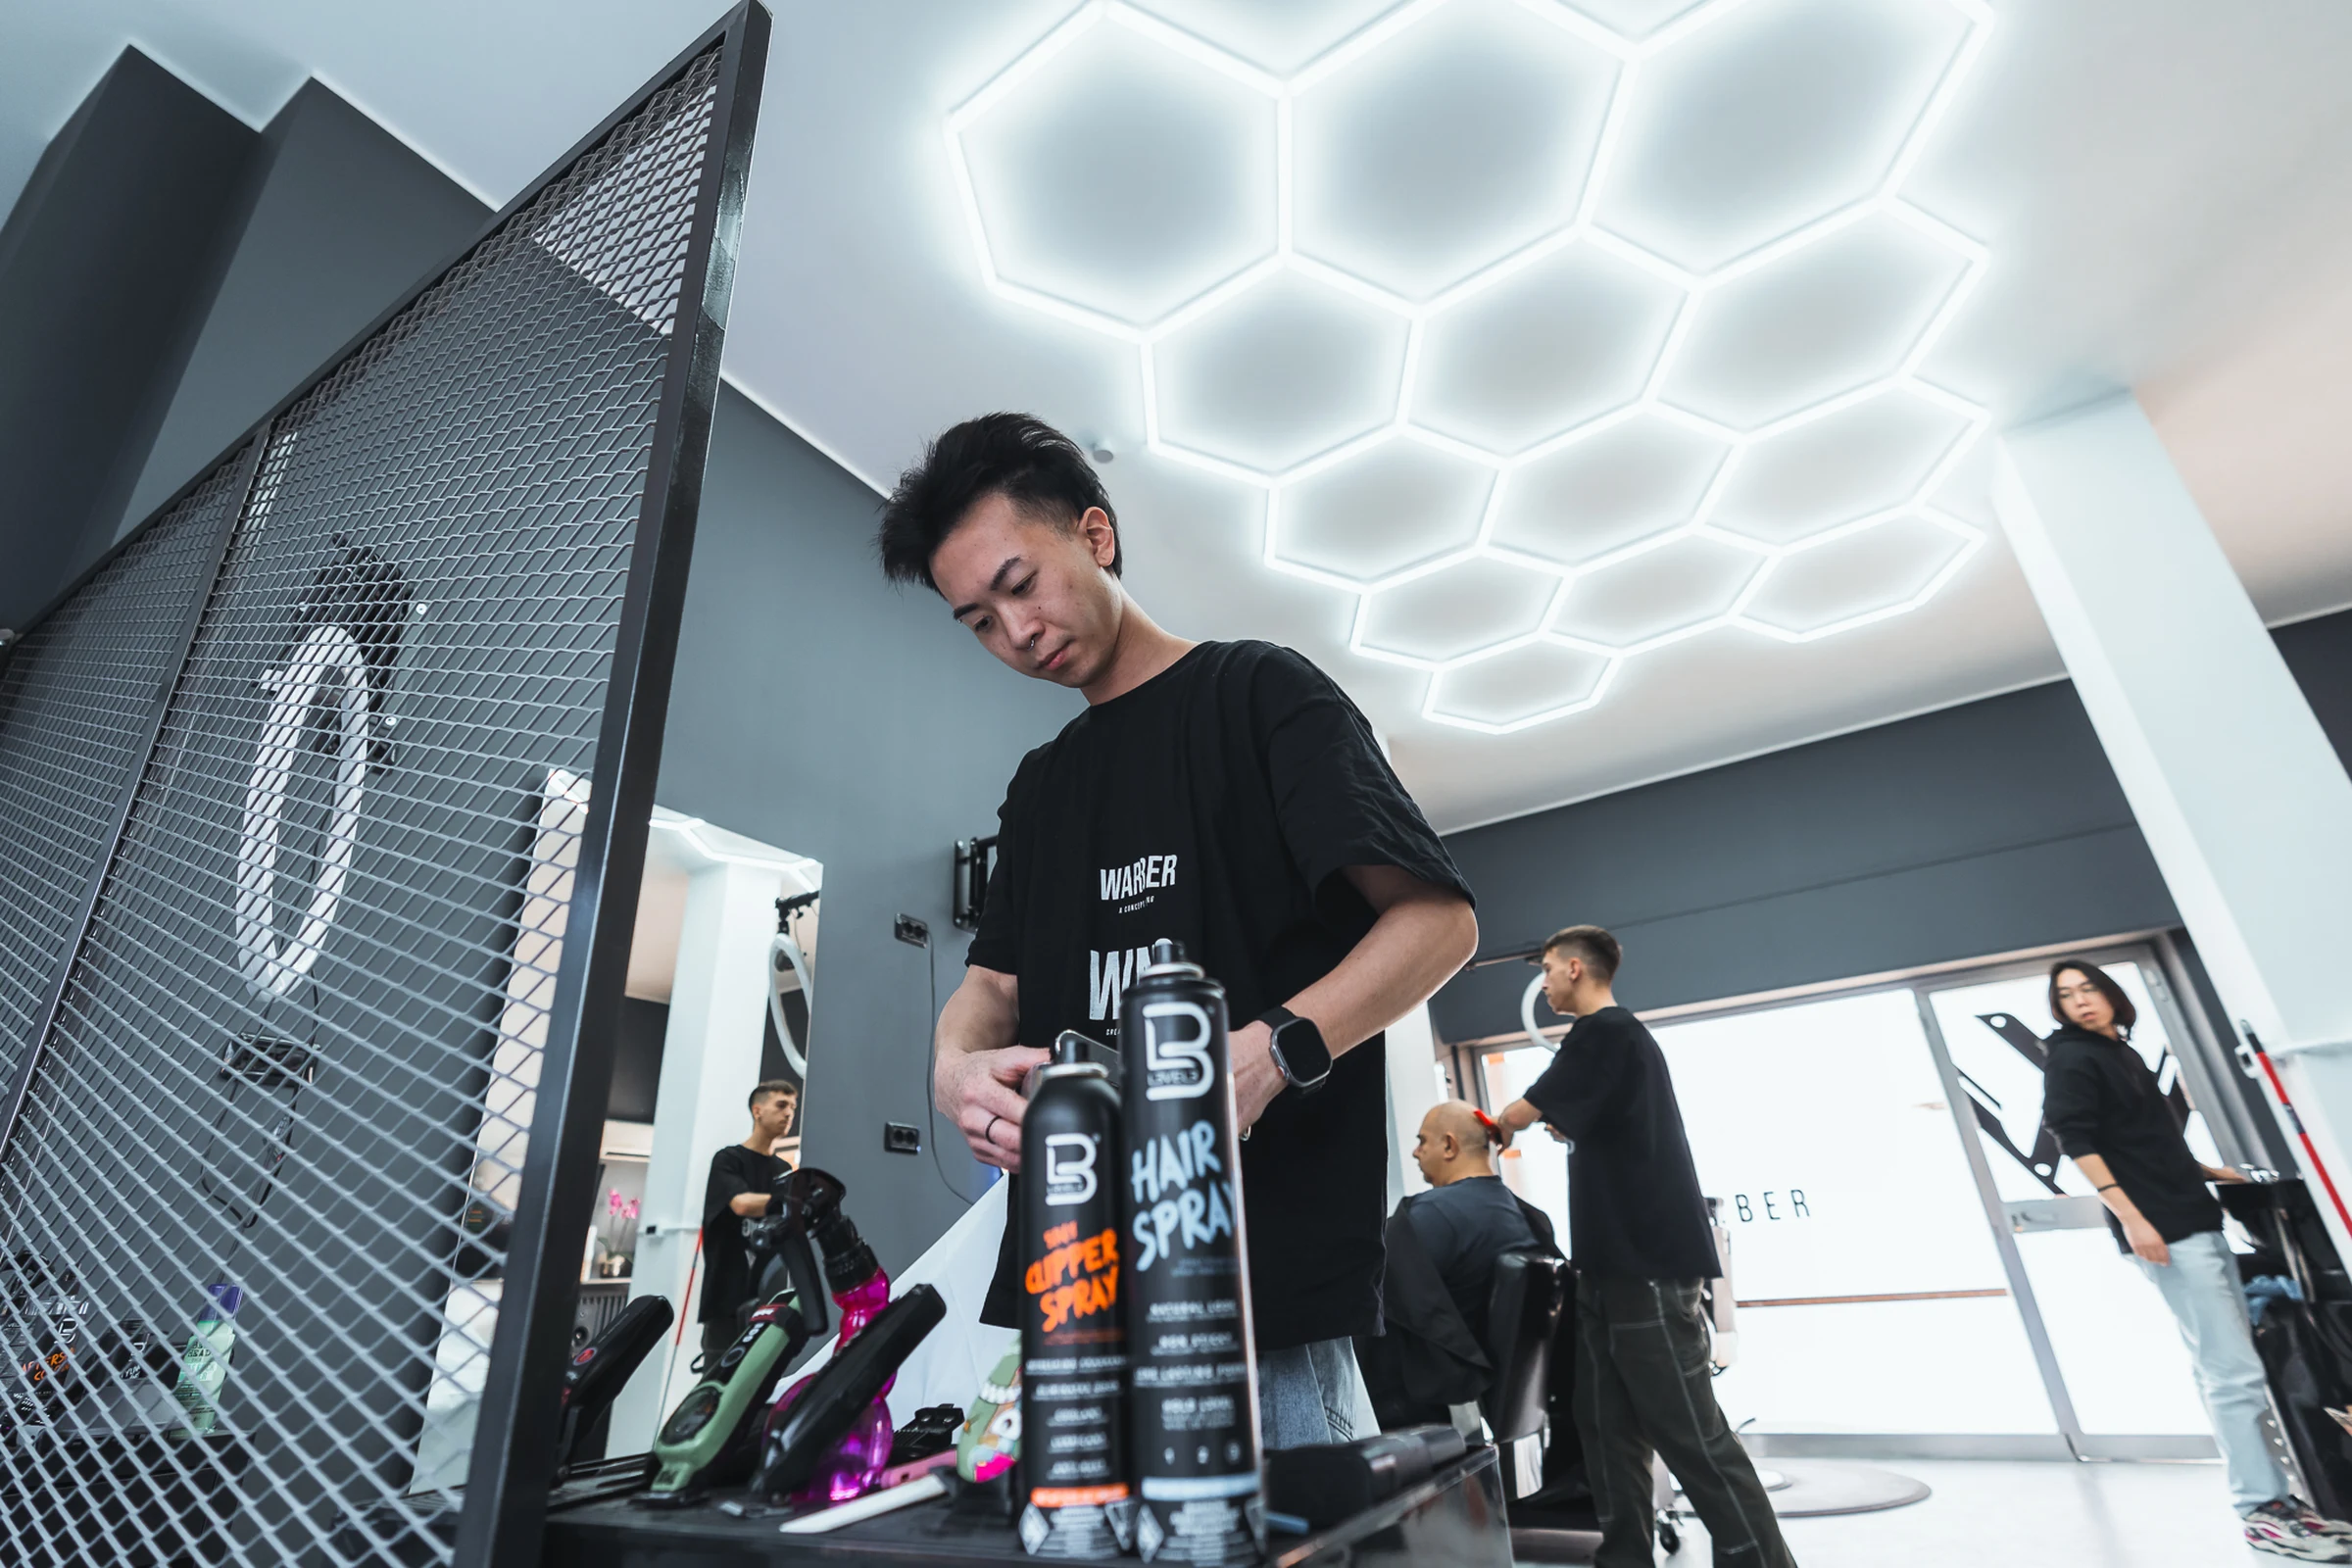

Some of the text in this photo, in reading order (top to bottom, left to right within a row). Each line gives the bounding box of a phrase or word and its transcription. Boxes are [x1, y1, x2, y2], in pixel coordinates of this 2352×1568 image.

[1131, 1120, 1222, 1204] HAIR
[1735, 1189, 1810, 1222] BER
[1024, 1227, 1120, 1295] CLIPPER
[1039, 1261, 1119, 1333] SPRAY
